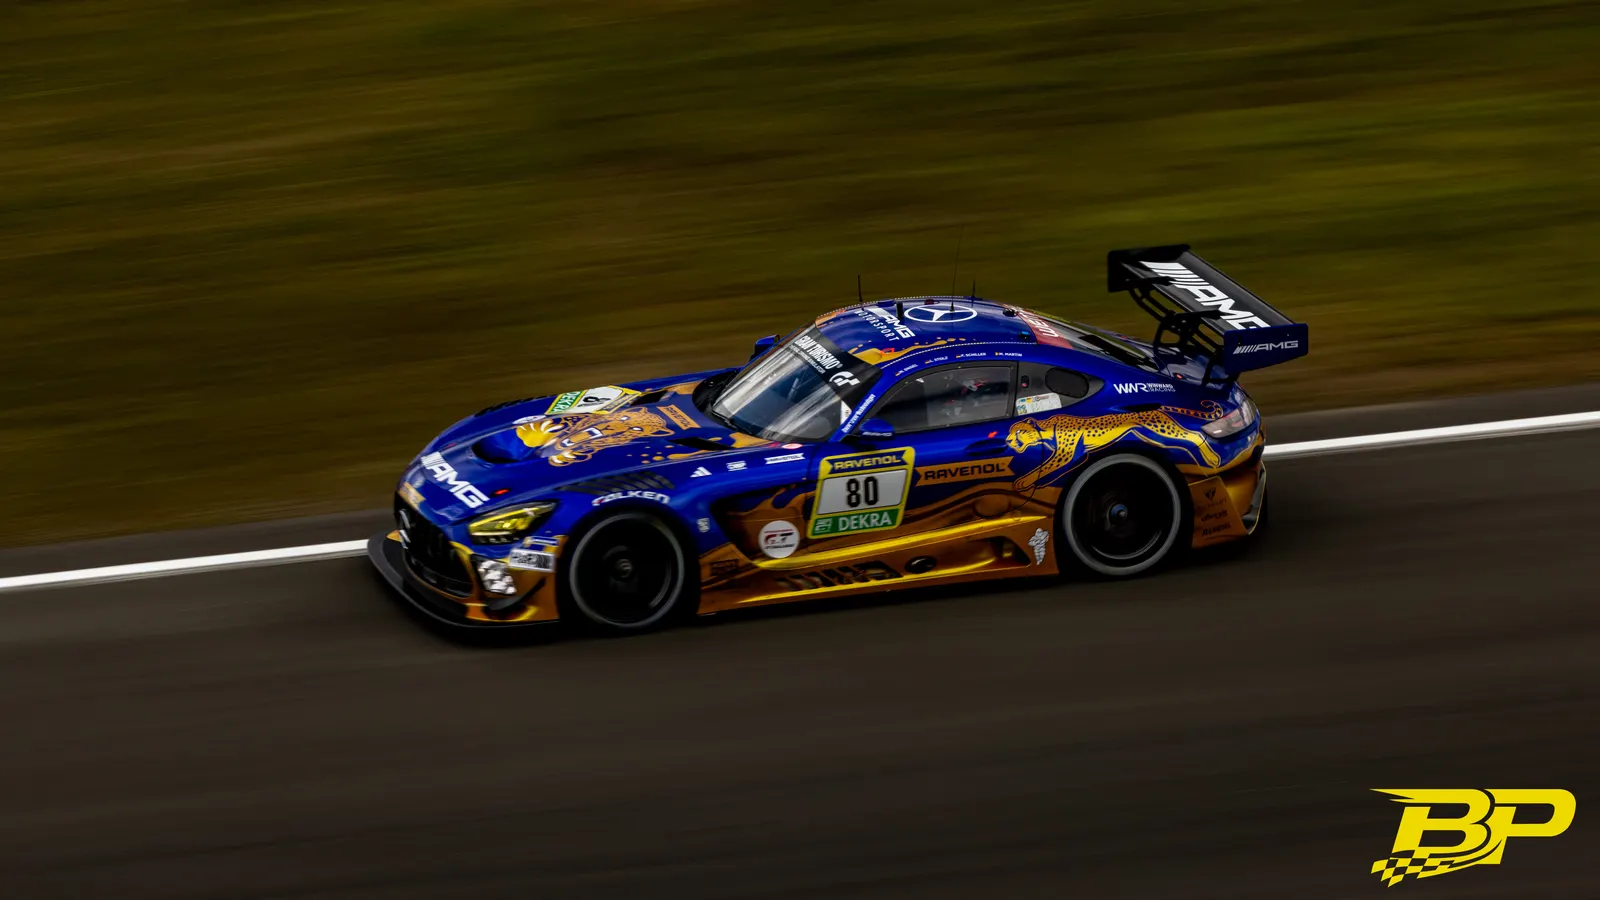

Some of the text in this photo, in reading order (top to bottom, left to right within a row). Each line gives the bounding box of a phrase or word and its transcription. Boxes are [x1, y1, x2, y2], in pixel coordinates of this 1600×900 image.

[854, 310, 900, 342] MOTORSPORT
[794, 335, 818, 350] GRAN
[833, 455, 902, 471] RAVENOL
[924, 462, 1002, 481] RAVENOL
[425, 463, 491, 509] AMG
[846, 476, 879, 508] 80
[591, 490, 671, 507] FALKEN
[838, 511, 892, 532] DEKRA
